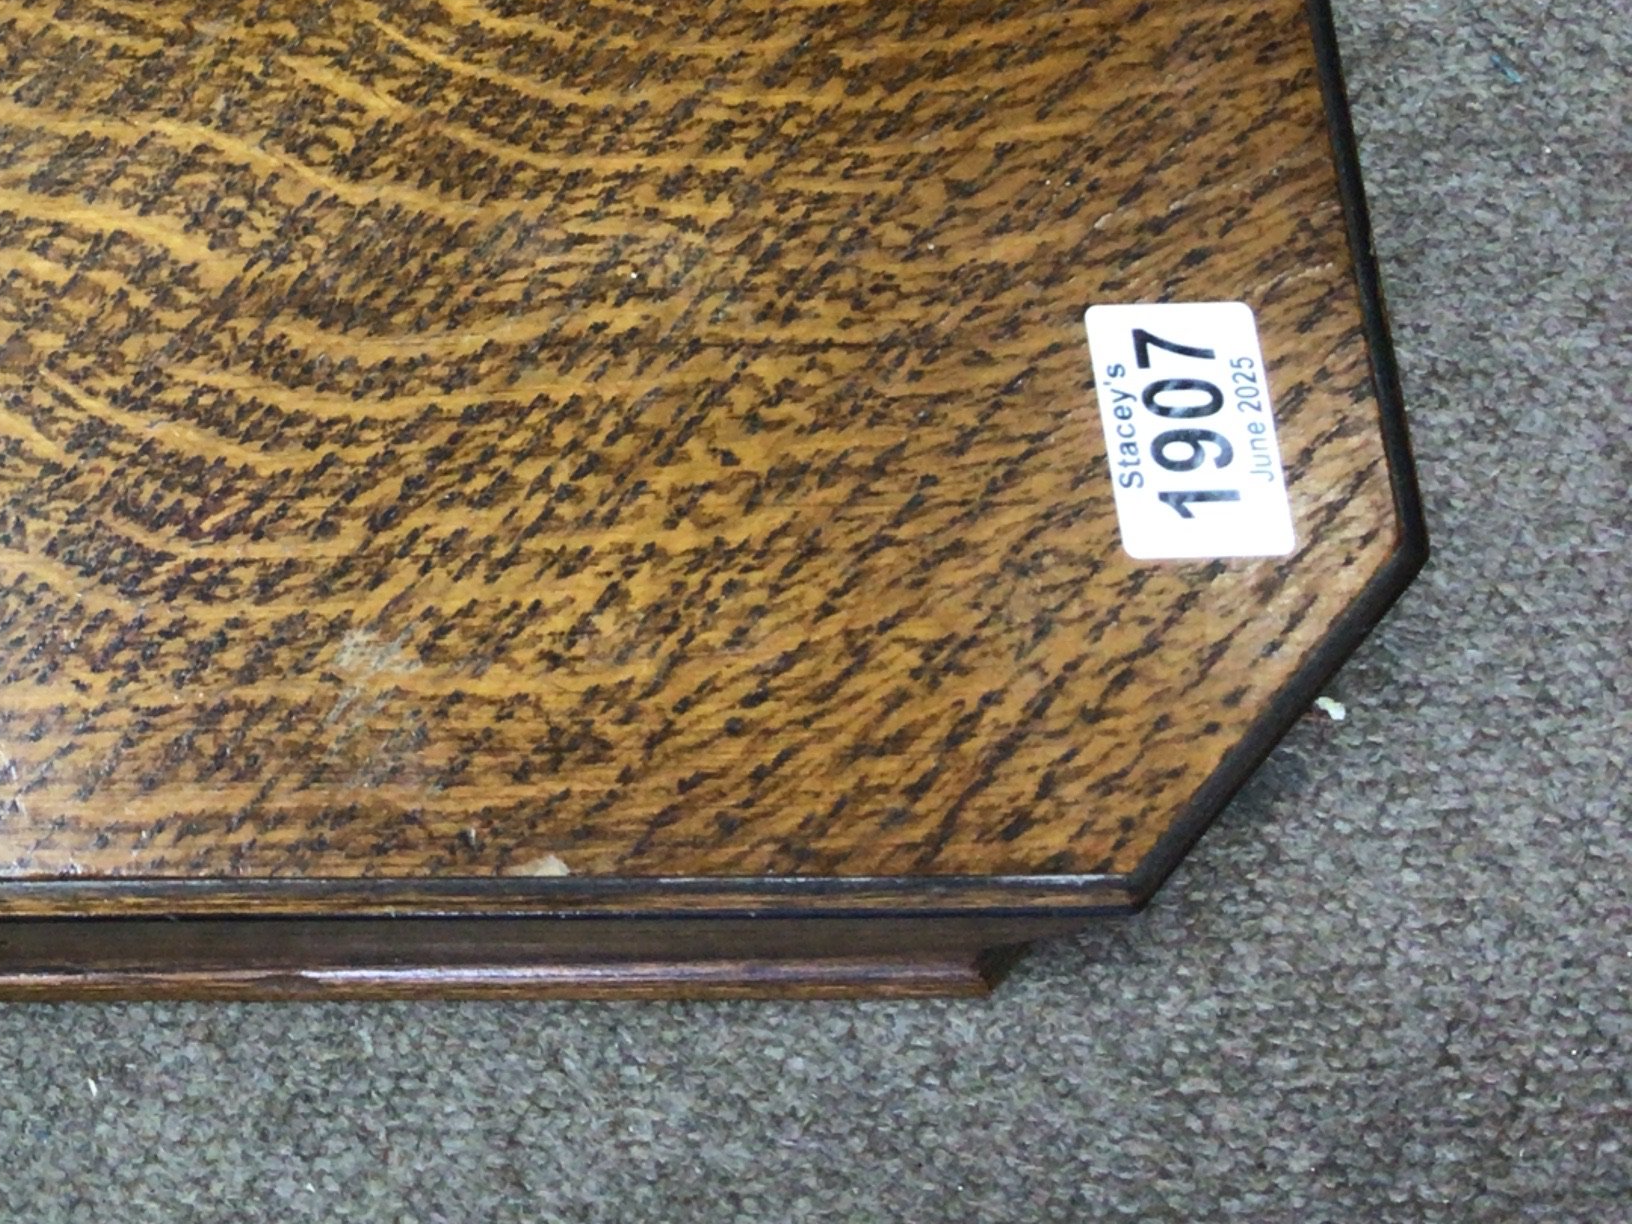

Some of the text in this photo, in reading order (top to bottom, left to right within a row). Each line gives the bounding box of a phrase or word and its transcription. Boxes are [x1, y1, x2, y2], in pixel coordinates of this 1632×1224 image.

[1103, 363, 1144, 488] Stacey's
[1132, 329, 1241, 519] 1907
[1230, 356, 1274, 482] June 2025
